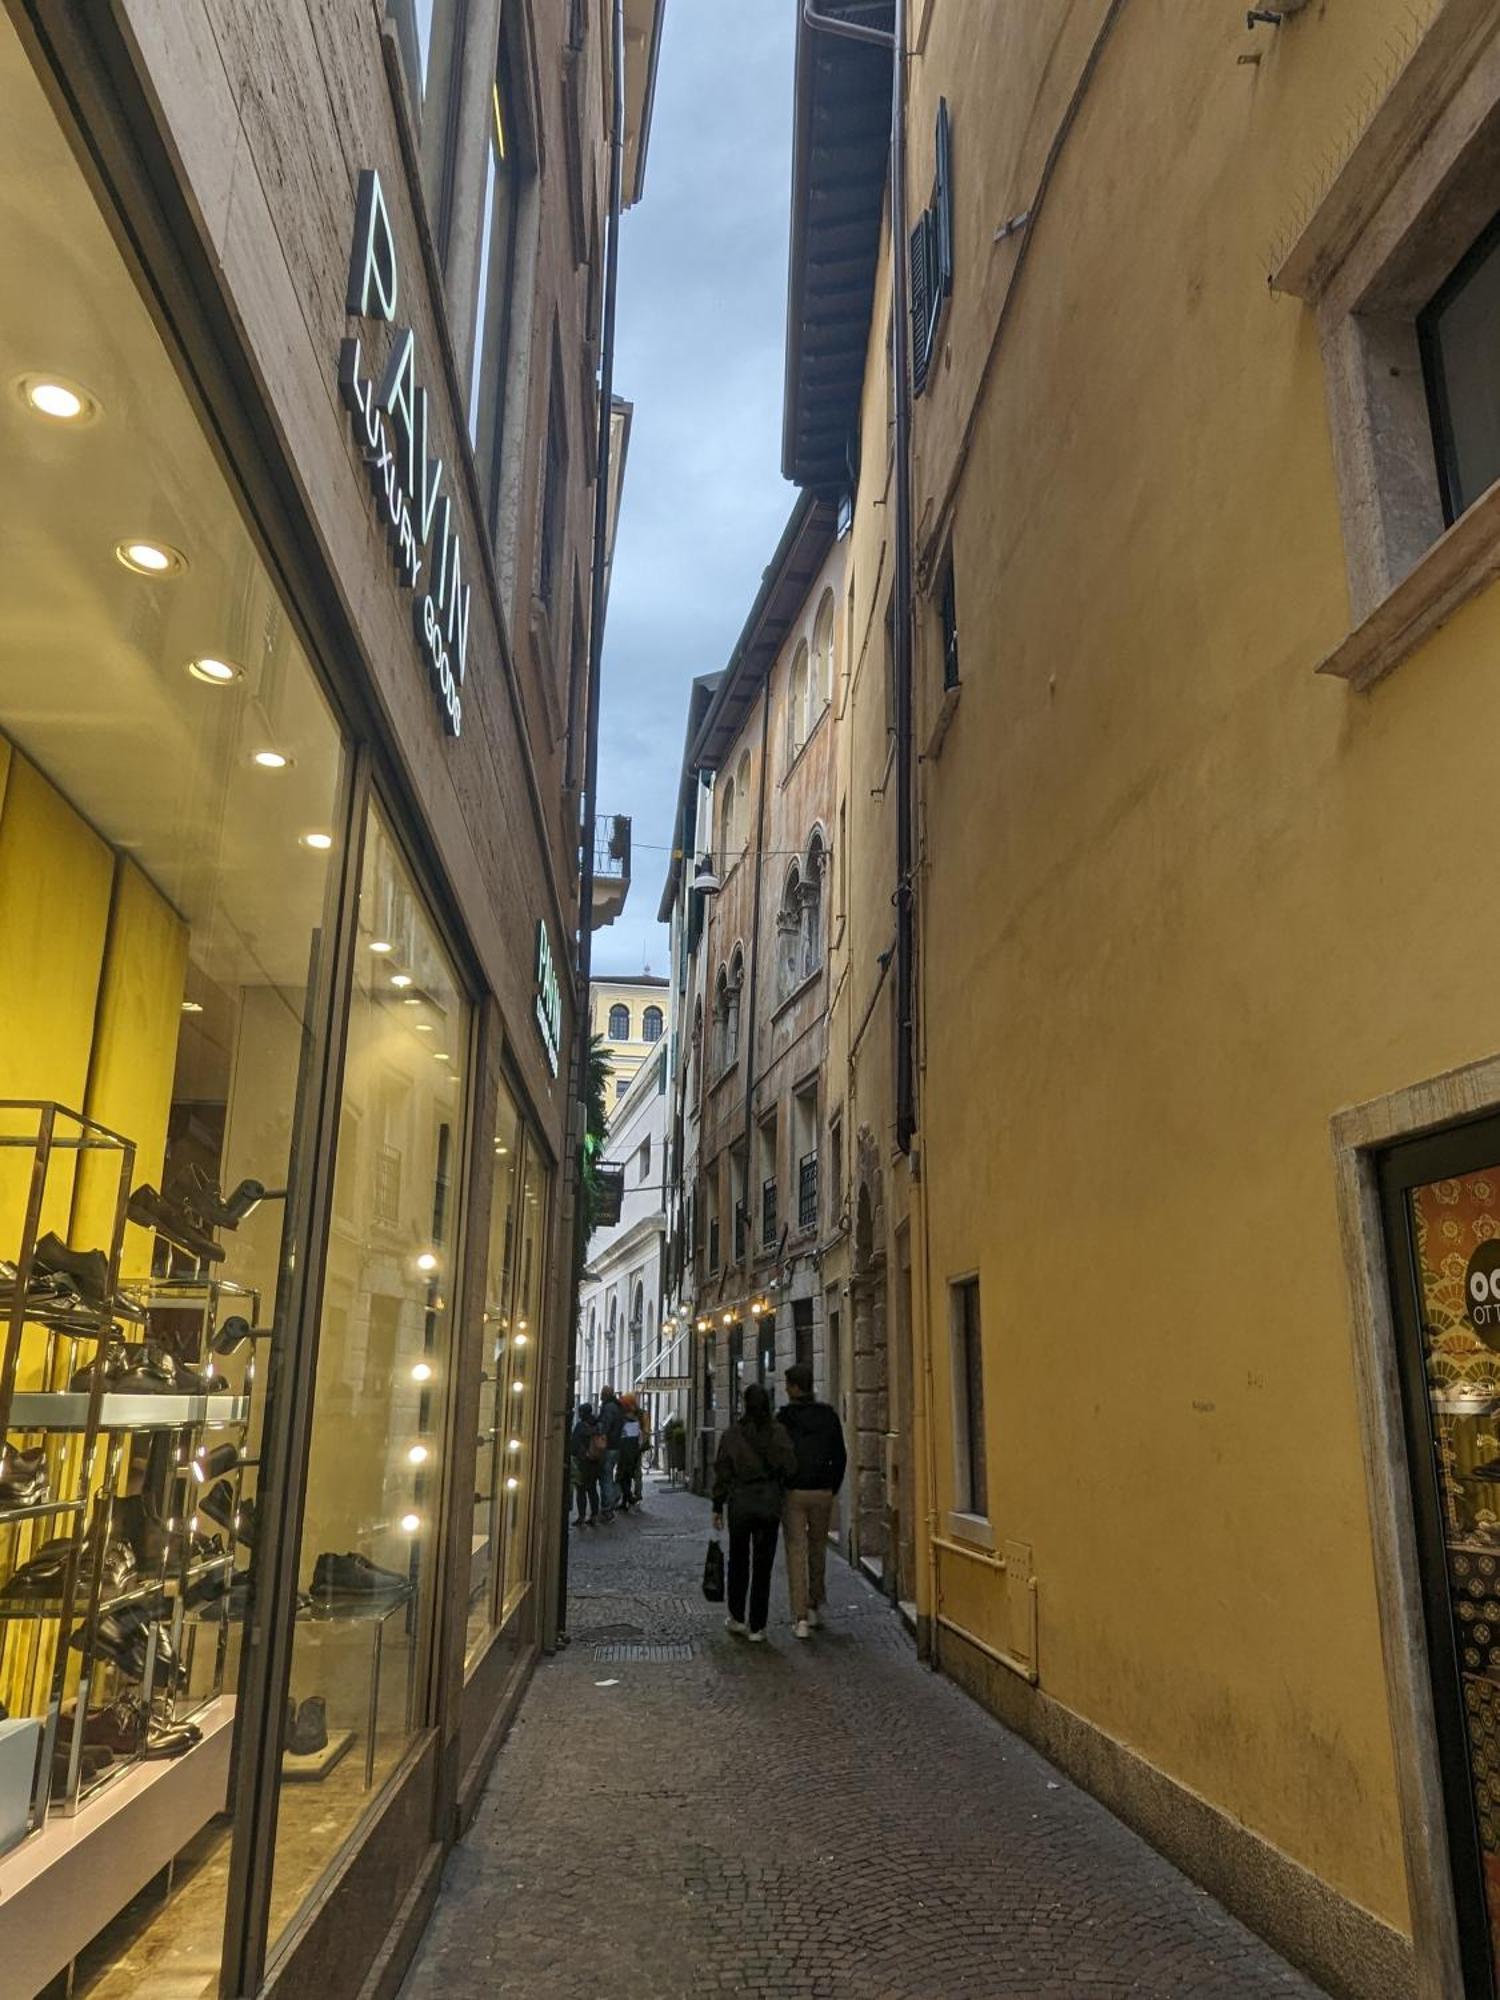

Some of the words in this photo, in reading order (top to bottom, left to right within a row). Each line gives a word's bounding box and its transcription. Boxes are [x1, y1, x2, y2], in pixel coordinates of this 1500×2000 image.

[353, 337, 422, 588] LUXURY
[423, 594, 462, 736] GOODS
[361, 169, 470, 684] PAVIN
